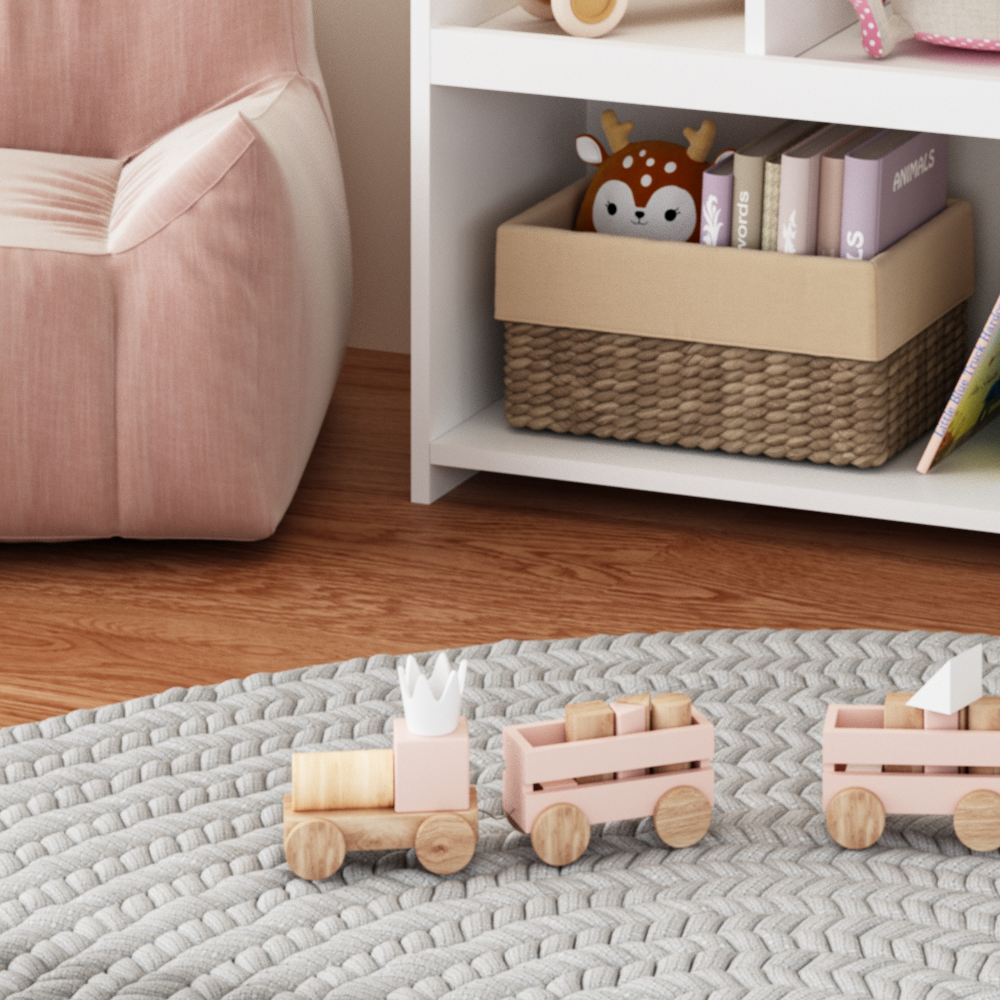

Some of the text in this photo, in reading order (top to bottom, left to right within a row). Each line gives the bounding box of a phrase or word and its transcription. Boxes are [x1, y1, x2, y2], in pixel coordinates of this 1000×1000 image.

[893, 149, 935, 192] ANIMALS
[933, 407, 954, 437] Little
[949, 380, 969, 405] Blue
[963, 345, 985, 377] Truck
